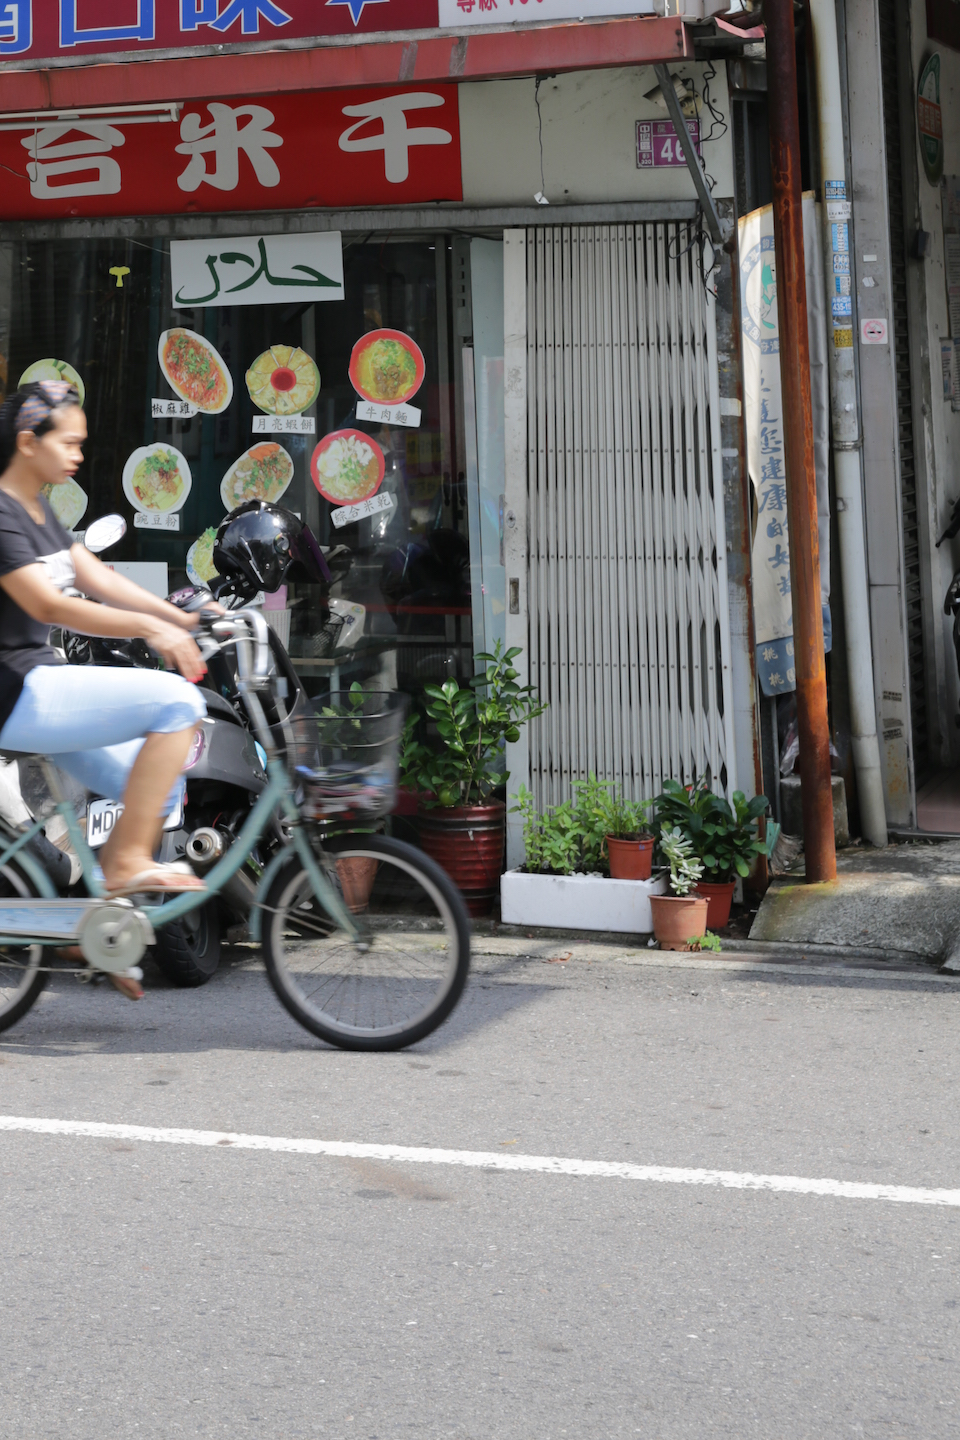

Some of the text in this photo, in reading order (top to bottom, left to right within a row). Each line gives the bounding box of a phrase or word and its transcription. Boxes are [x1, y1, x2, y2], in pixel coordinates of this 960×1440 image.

[175, 237, 342, 304] حلال
[256, 417, 314, 431] 月亮蝦餅
[365, 407, 408, 424] 牛肉麵
[335, 495, 390, 524] 綜合米乾
